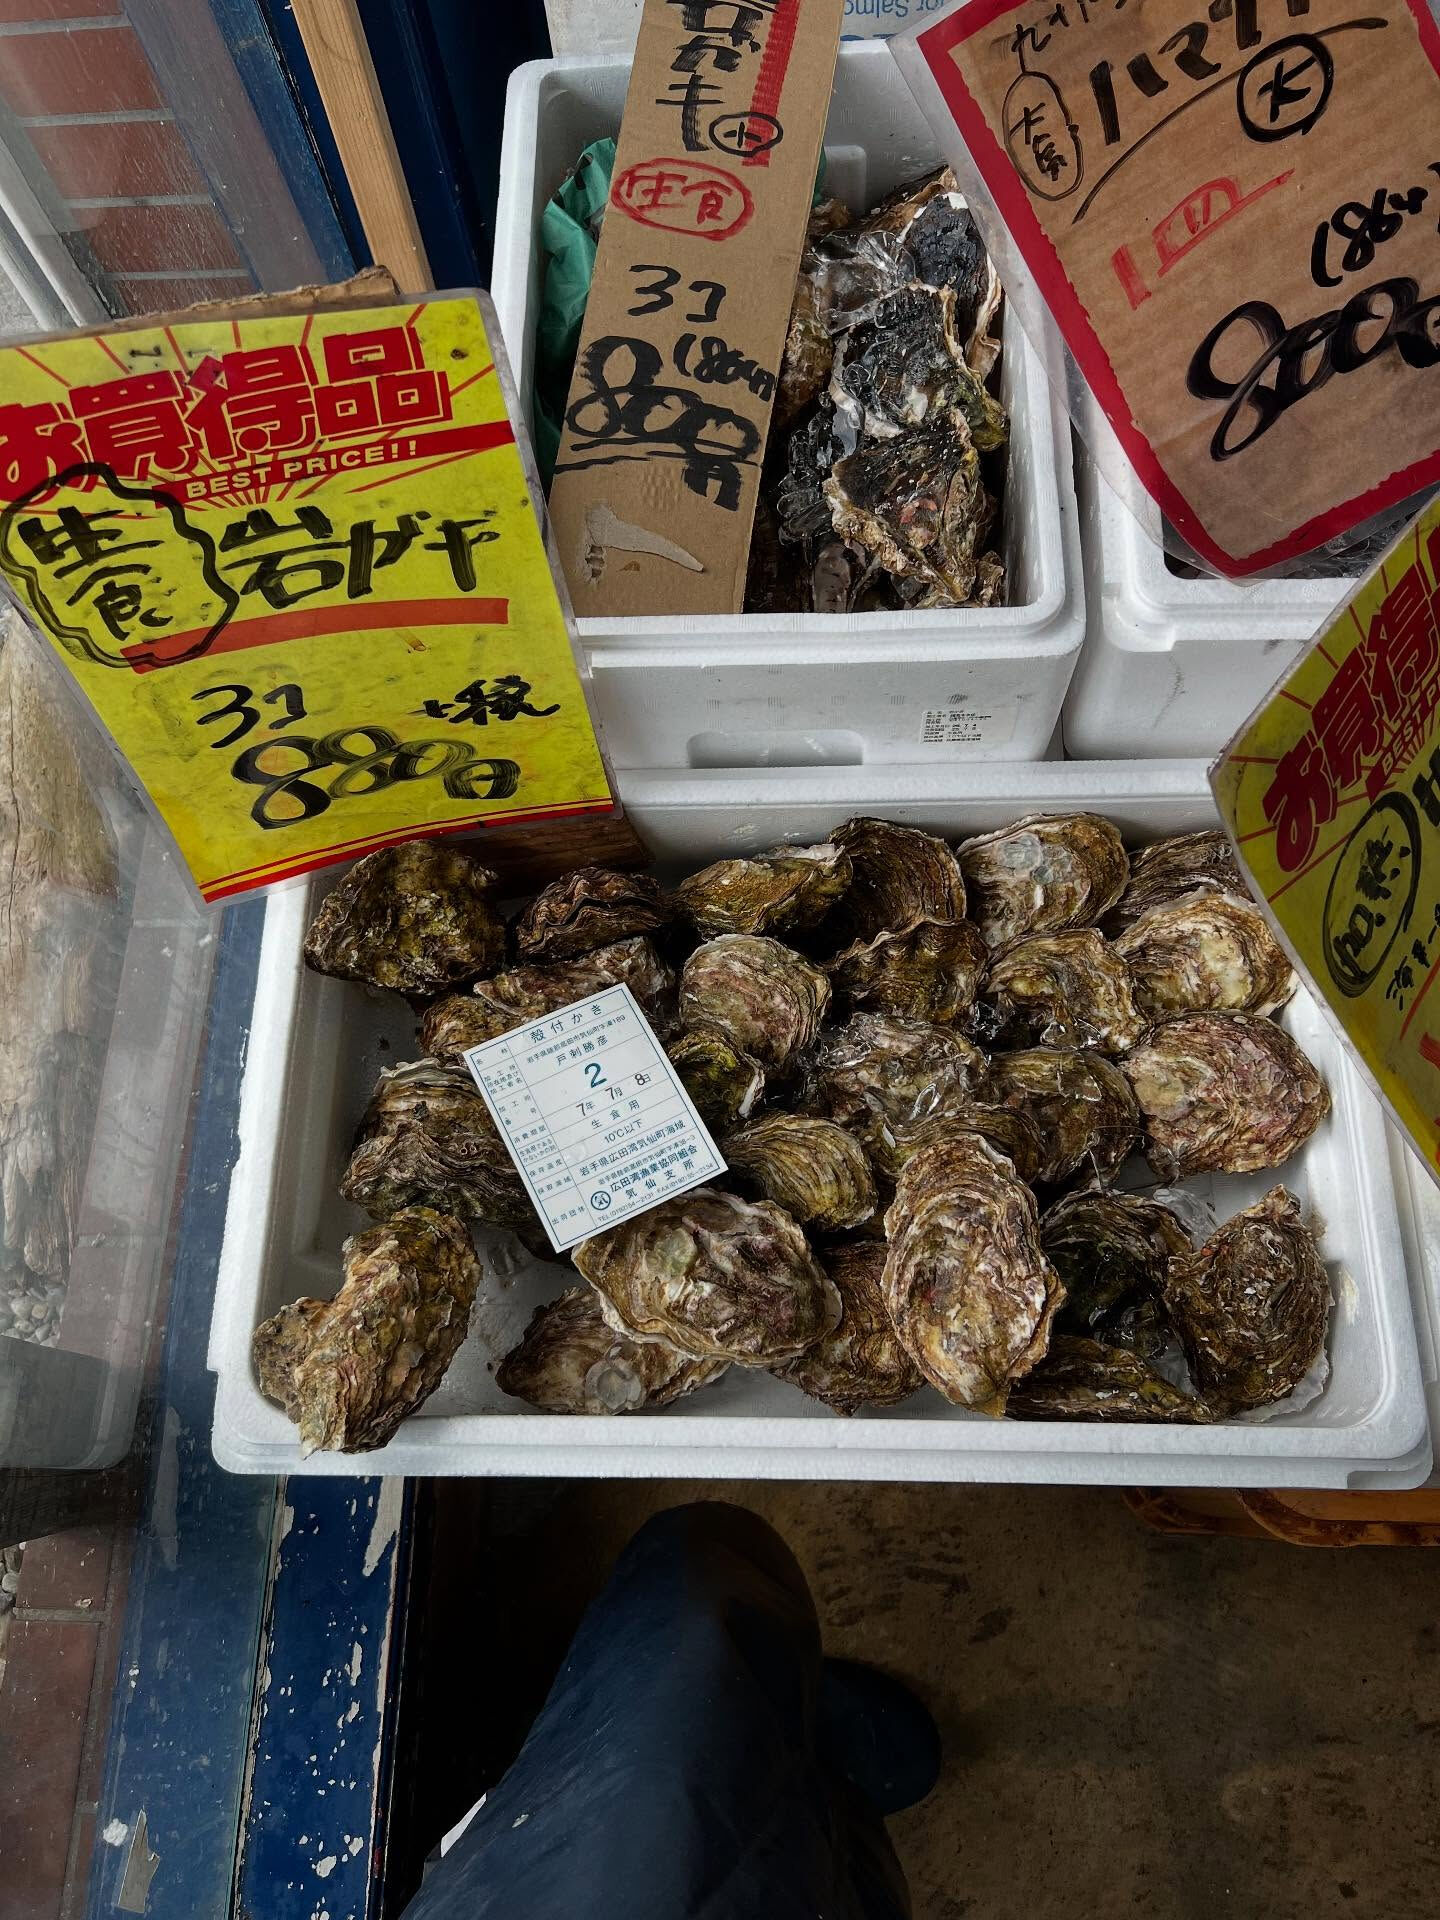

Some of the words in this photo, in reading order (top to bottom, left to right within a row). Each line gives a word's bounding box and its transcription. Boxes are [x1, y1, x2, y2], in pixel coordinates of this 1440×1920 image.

[0, 327, 453, 503] お買得品
[186, 466, 272, 499] BEST
[285, 440, 418, 479] PRICE!!
[1262, 522, 1440, 873] お買得
[1382, 703, 1421, 776] BEST
[528, 1002, 604, 1043] 殻付かき
[581, 1060, 608, 1088] 2
[589, 1098, 640, 1129] 生食用
[608, 1143, 699, 1193] 広田湾漁業協同組合
[624, 1158, 695, 1199] 気仙支所
